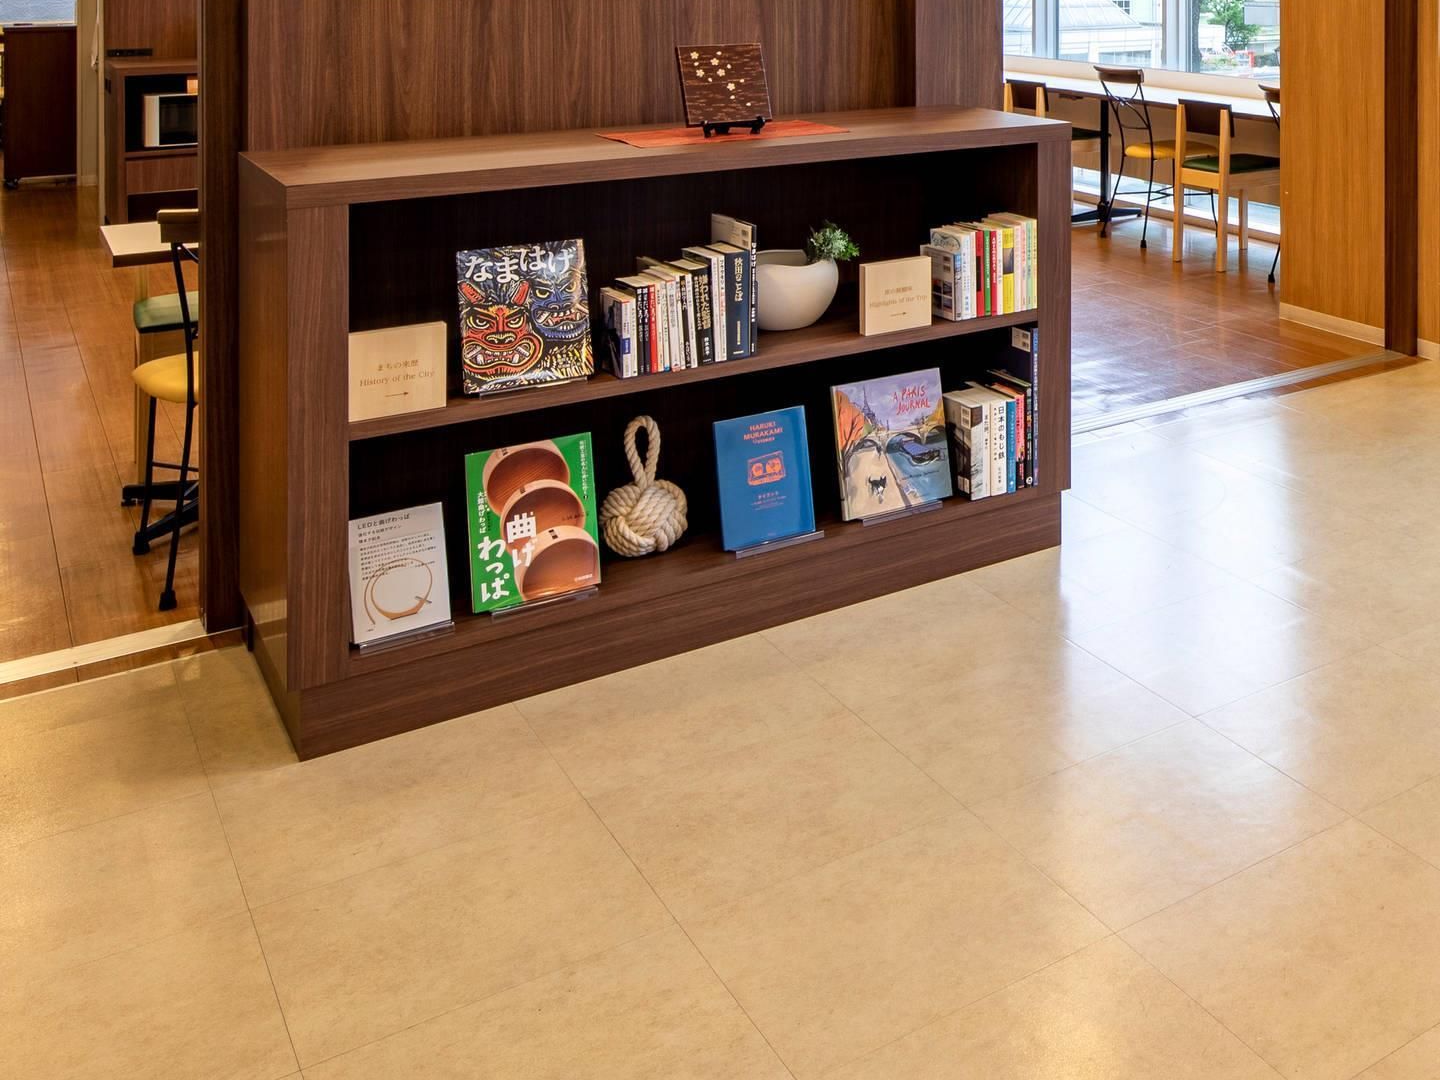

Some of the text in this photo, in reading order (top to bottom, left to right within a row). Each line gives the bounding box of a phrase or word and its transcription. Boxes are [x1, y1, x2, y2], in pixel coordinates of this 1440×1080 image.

[465, 245, 574, 284] なまはげ
[360, 369, 434, 387] History of the City
[902, 385, 926, 400] PARIS
[896, 398, 931, 415] JOURNAL
[743, 427, 783, 440] MURAKAMI
[749, 420, 776, 431] HARUKI
[506, 511, 538, 569] 曲げ
[478, 536, 510, 603] わっぱ
